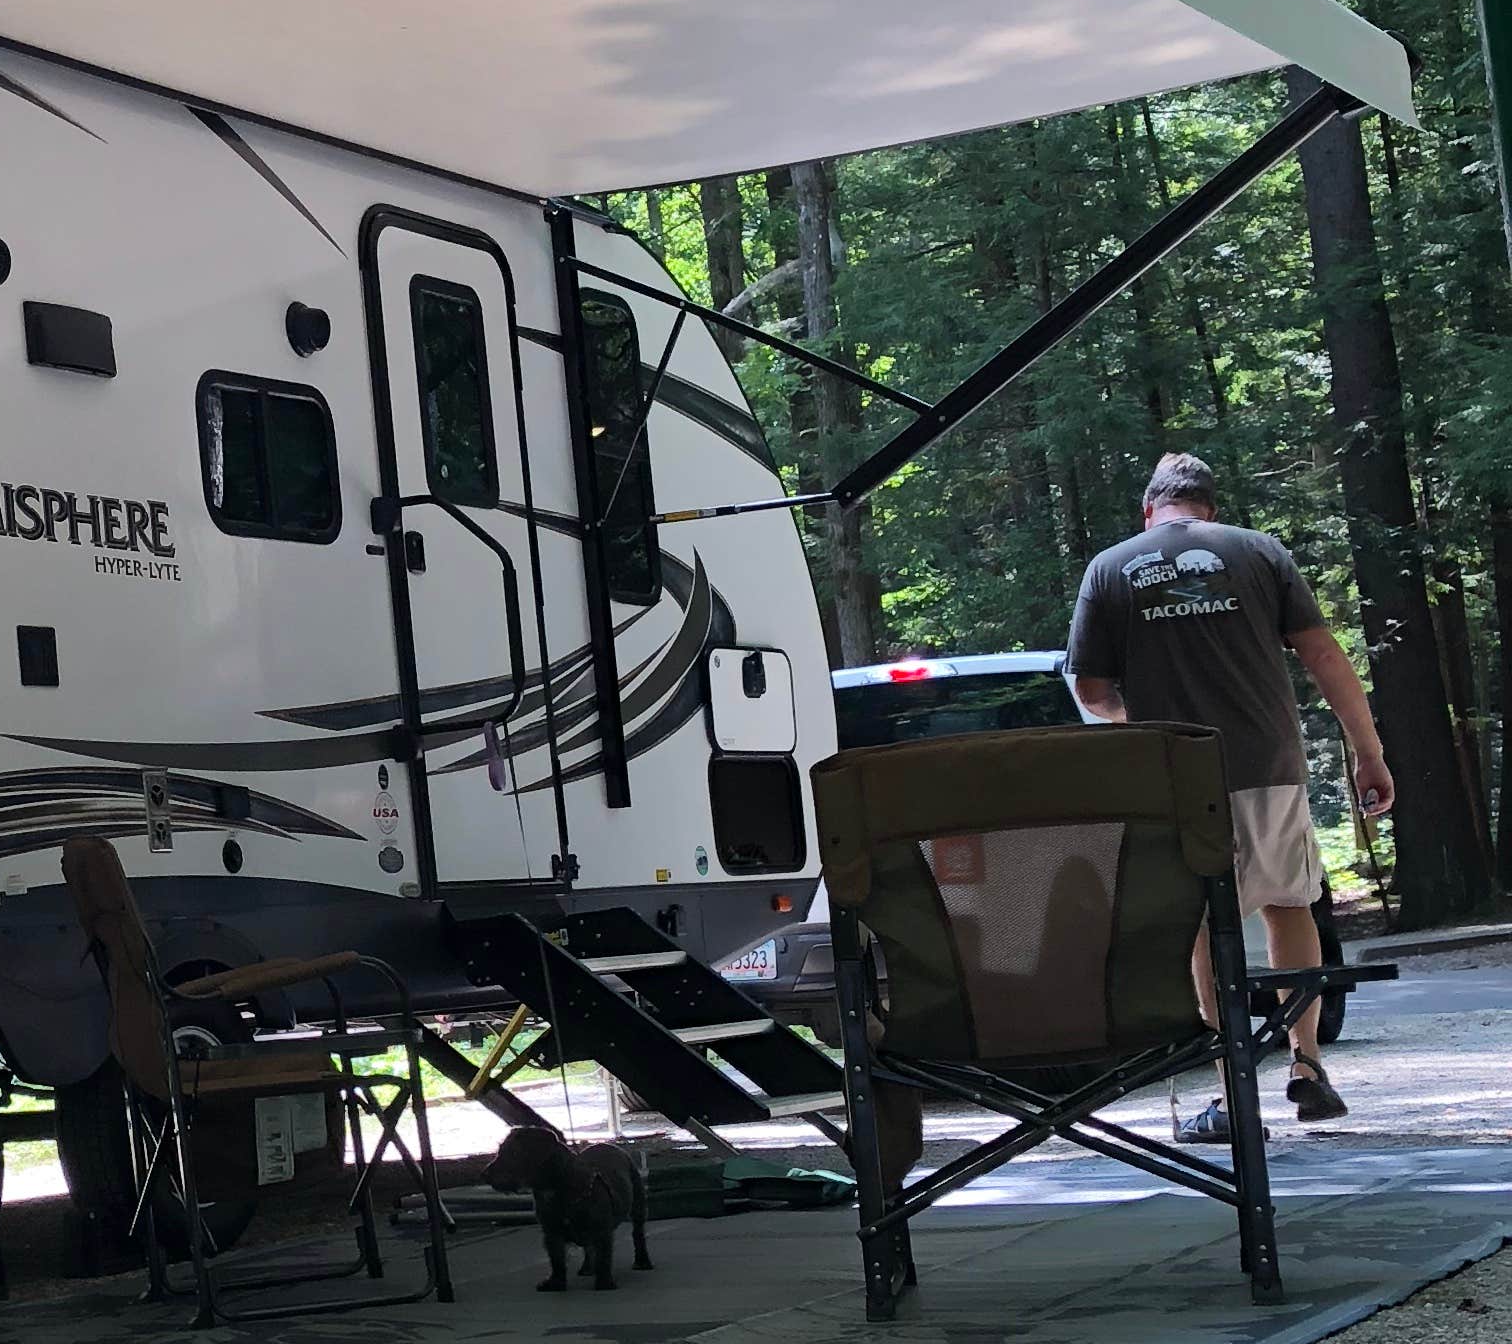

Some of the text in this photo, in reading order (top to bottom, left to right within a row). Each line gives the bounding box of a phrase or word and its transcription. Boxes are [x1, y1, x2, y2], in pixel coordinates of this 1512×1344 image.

[94, 555, 182, 582] HYPER-LYTE
[1139, 566, 1161, 578] SAVE
[373, 808, 399, 818] USA
